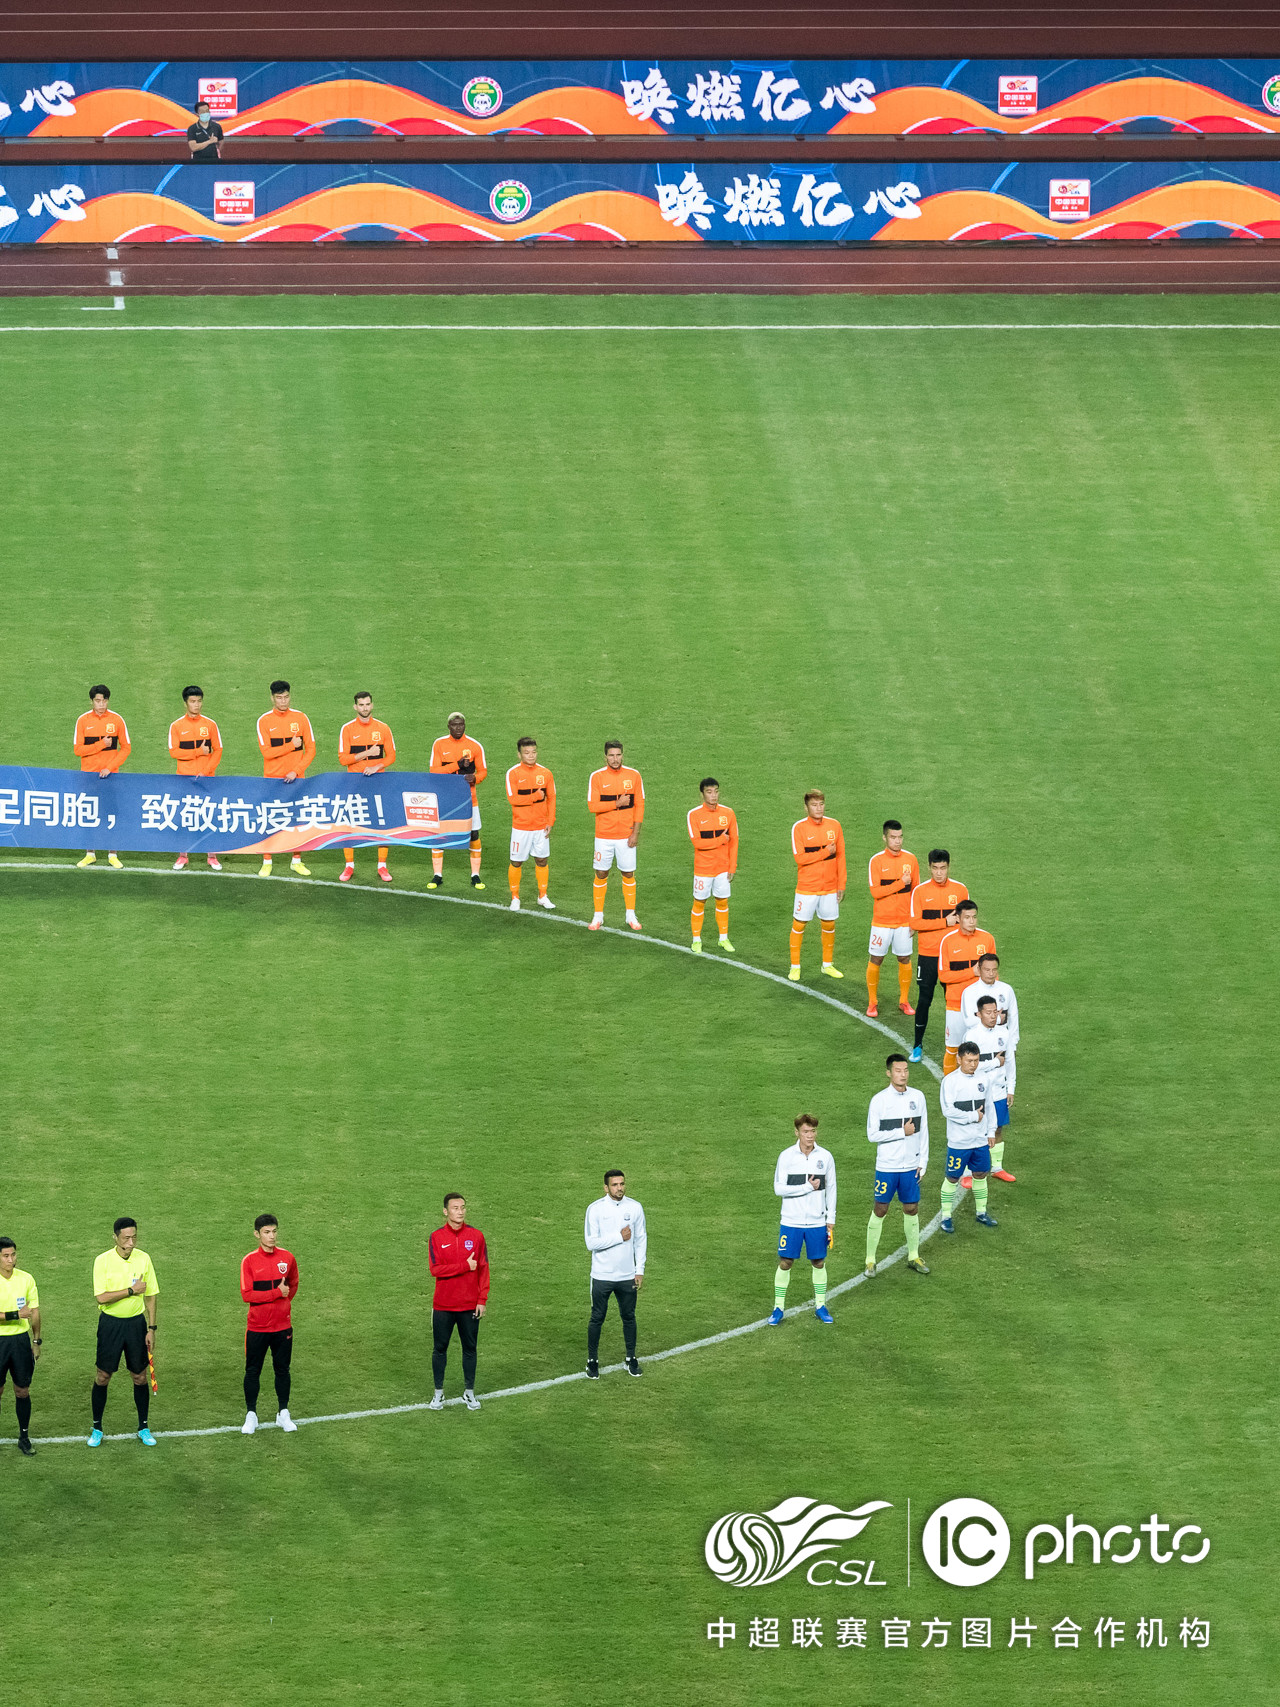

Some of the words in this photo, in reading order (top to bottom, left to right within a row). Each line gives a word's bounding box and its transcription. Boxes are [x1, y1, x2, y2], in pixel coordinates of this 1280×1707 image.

[621, 68, 877, 125] 唤燃亿心
[655, 172, 922, 230] 唤燃亿心
[512, 841, 520, 853] 11
[796, 901, 803, 911] 3
[871, 934, 883, 947] 24
[948, 1155, 962, 1169] 33
[874, 1180, 888, 1194] 23
[779, 1235, 788, 1247] 6
